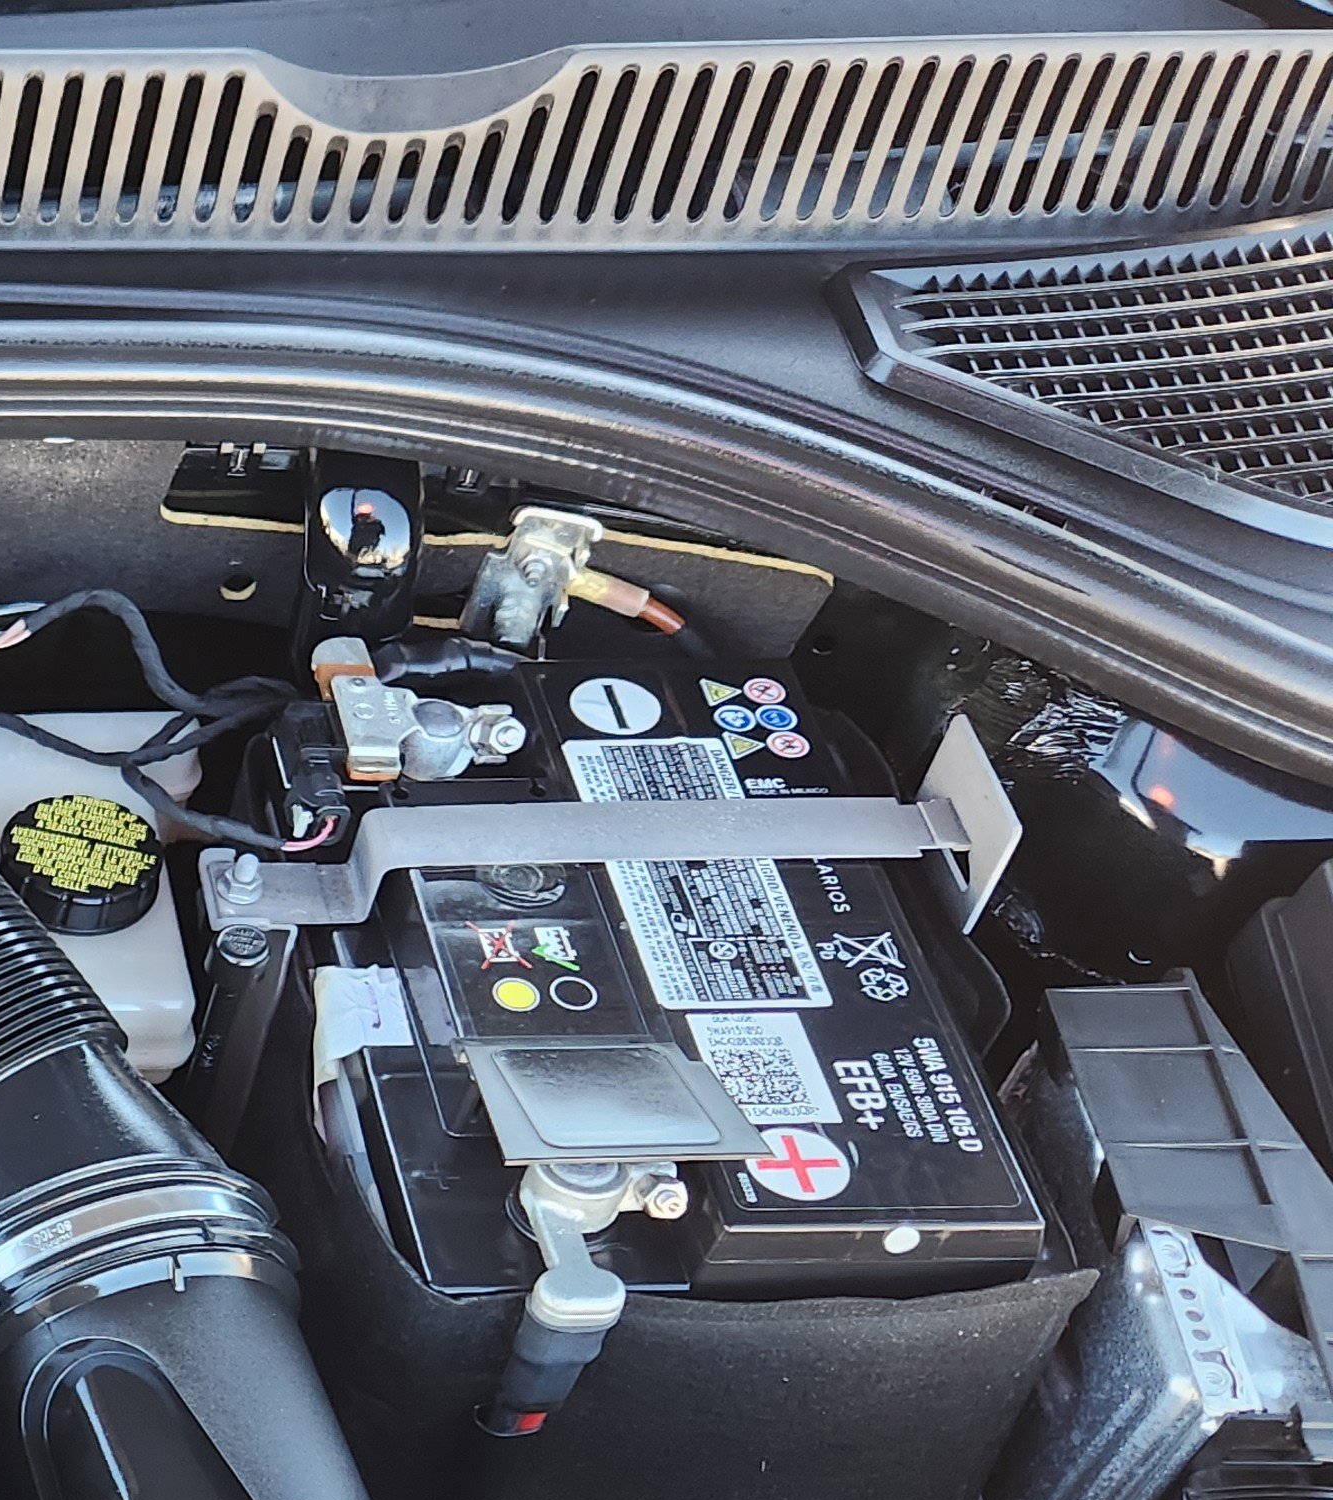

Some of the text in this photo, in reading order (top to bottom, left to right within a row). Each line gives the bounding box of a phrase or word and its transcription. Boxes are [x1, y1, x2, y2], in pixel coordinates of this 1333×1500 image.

[744, 778, 786, 789] EMC
[119, 811, 138, 822] CAP
[143, 852, 158, 865] LE
[815, 942, 836, 960] Pb
[872, 1052, 898, 1080] 640A
[833, 1060, 887, 1131] EFB+
[893, 1048, 950, 1143] 12V 59Ah 380A DIN
[912, 1037, 983, 1152] 5WA 915 105 D
